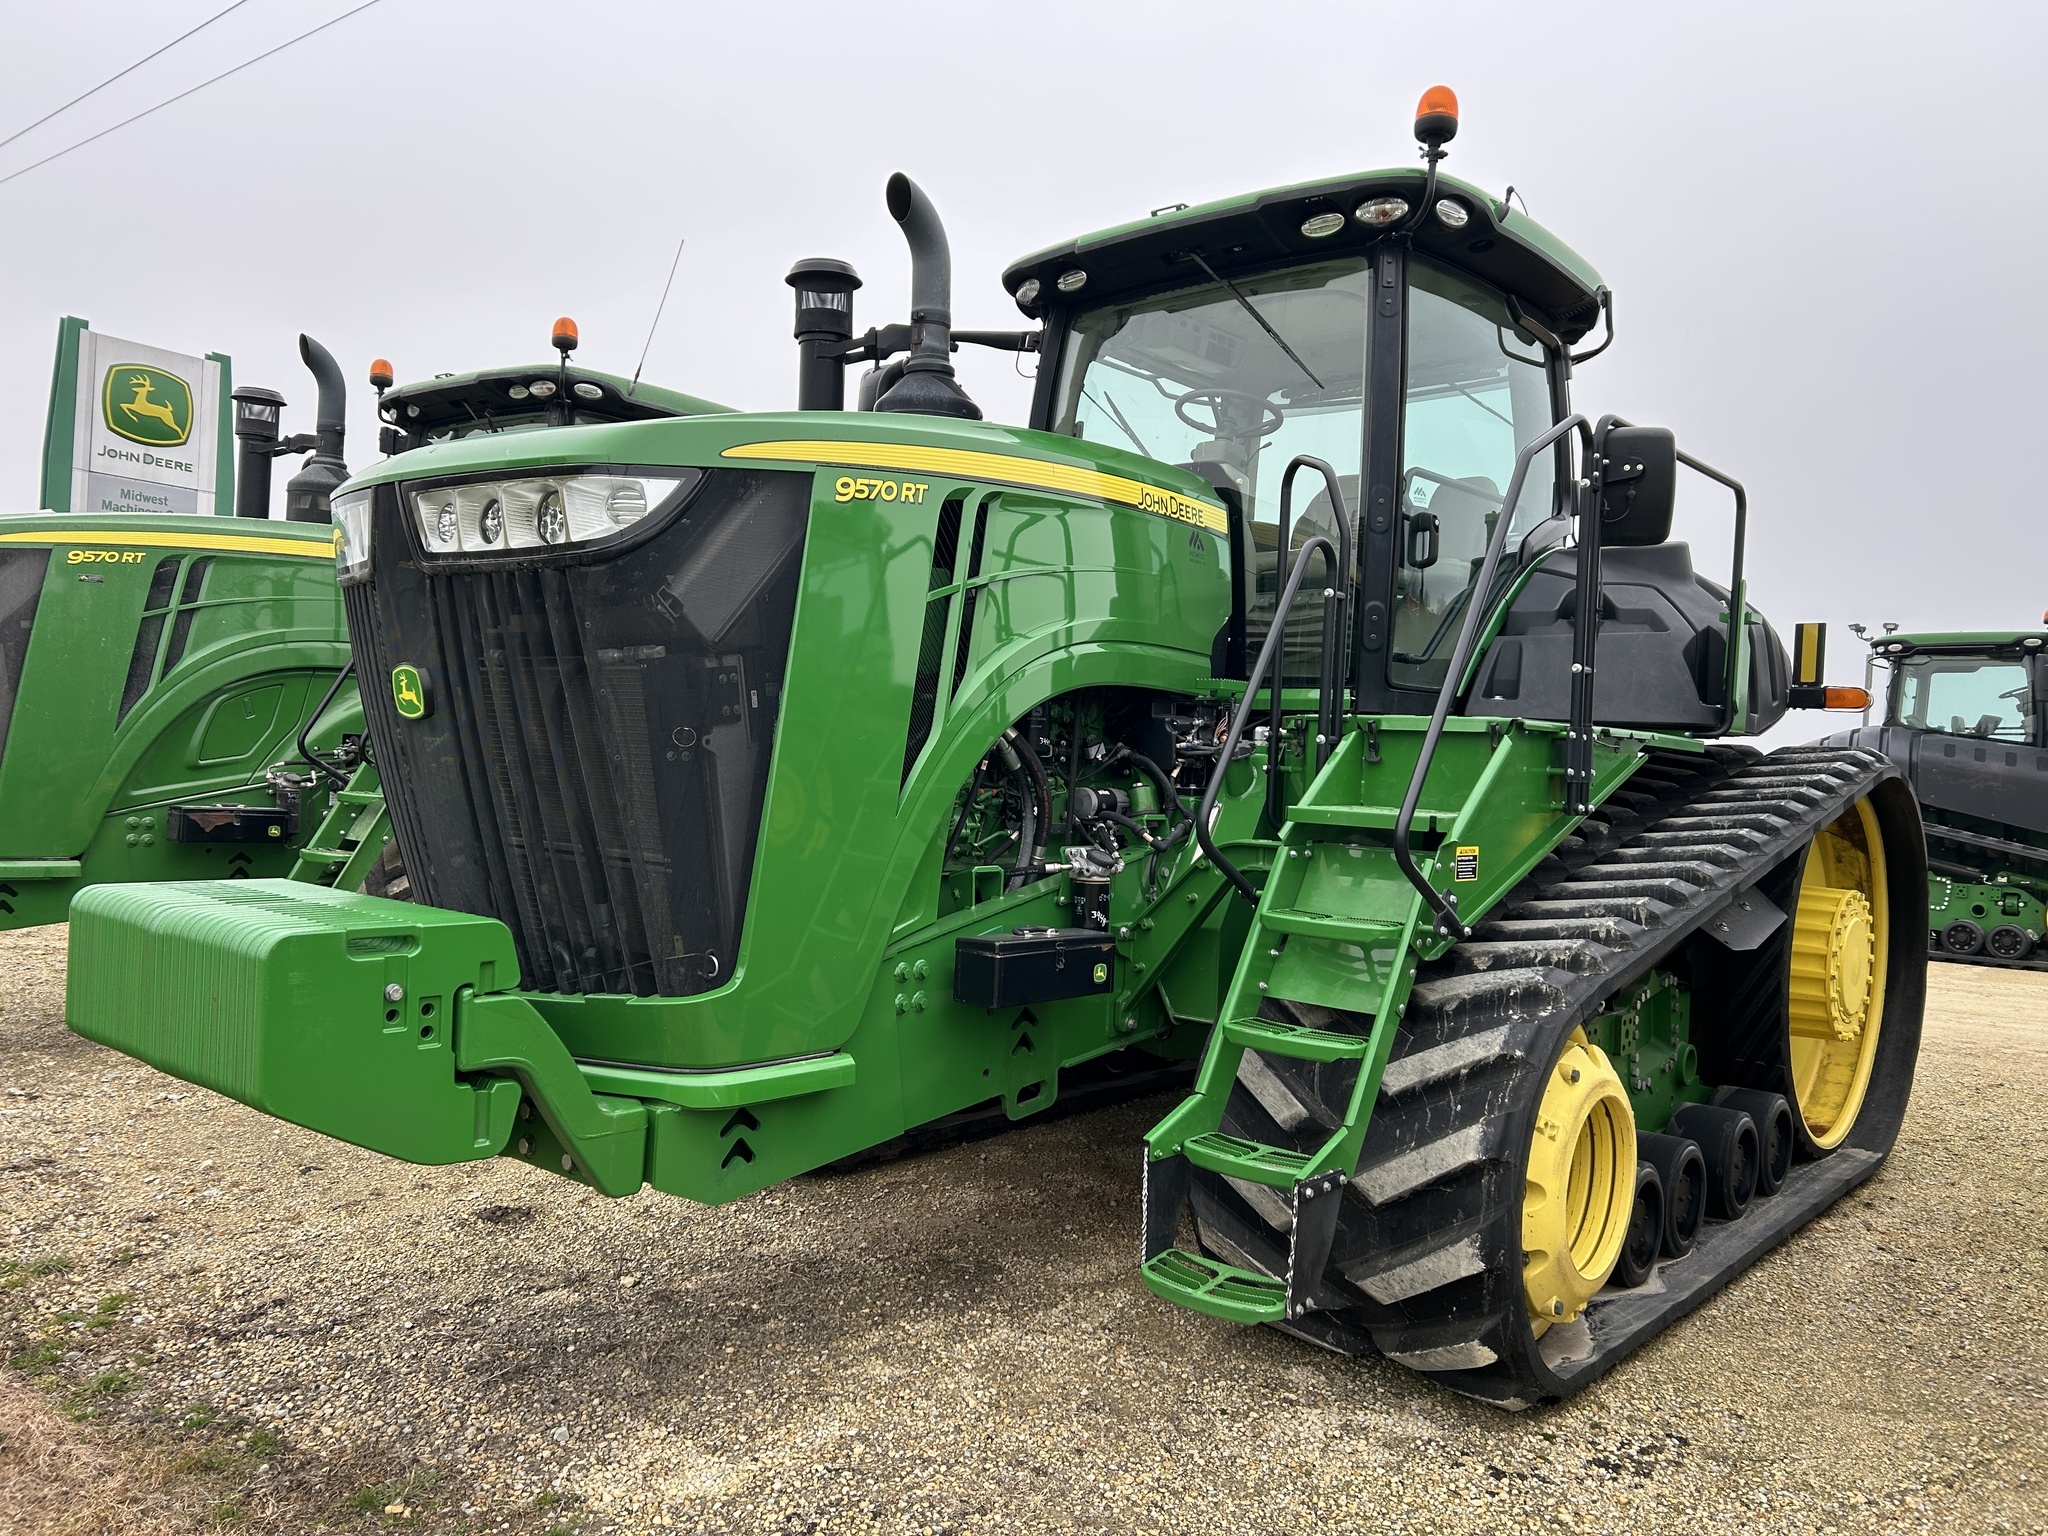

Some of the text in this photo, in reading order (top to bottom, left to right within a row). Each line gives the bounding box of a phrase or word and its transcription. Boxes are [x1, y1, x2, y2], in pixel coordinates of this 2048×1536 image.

[97, 445, 194, 473] JOHN DEERE
[120, 488, 169, 507] Midwest
[835, 476, 929, 504] 9570 RT
[101, 499, 162, 513] Machin
[1138, 487, 1205, 526] JOHN DEERE
[67, 550, 146, 565] 9570 RT
